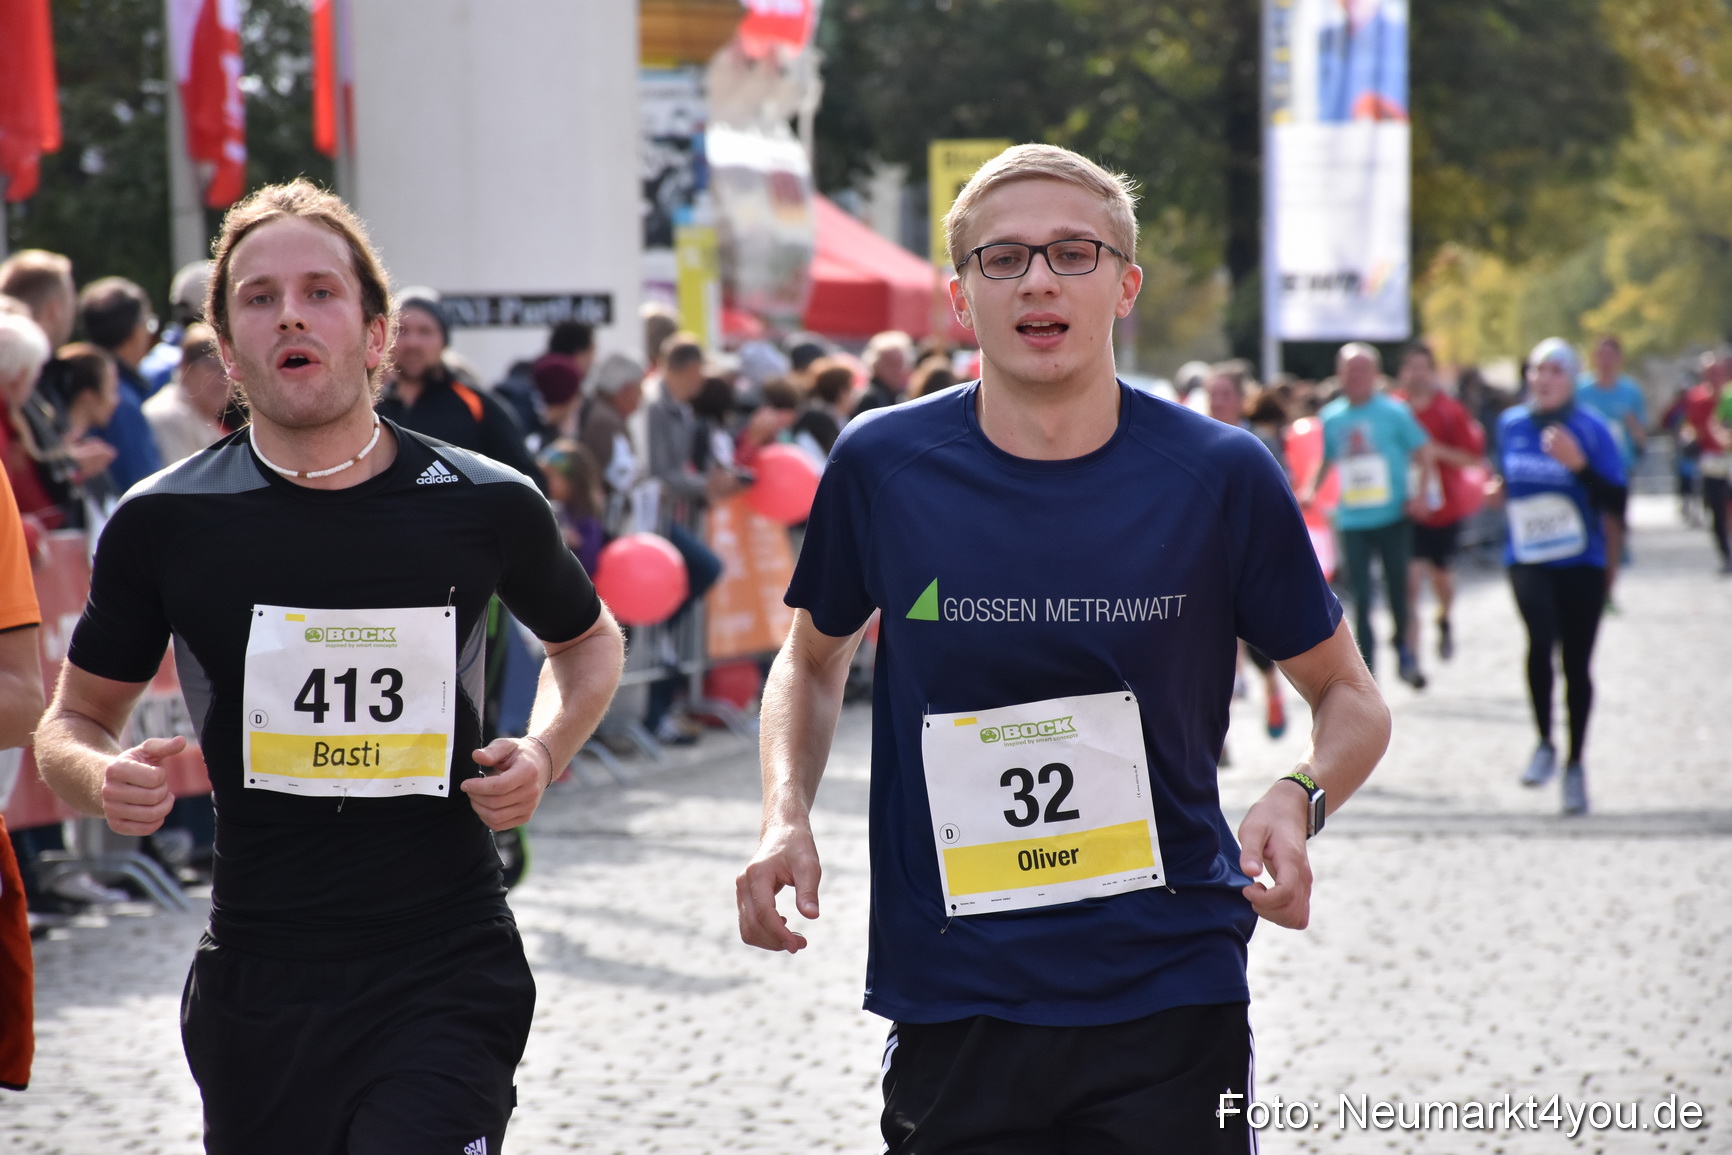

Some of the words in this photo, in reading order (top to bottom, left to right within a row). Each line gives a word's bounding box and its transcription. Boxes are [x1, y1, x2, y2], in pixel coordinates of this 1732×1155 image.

[416, 474, 459, 485] adidas
[943, 597, 1036, 622] GOSSEN
[1045, 594, 1187, 622] METRAWATT
[326, 627, 397, 643] BOCK
[293, 667, 404, 724] 413
[255, 714, 263, 724] D
[1001, 715, 1077, 741] BOCK
[1003, 739, 1027, 748] inspired
[1036, 736, 1053, 744] smart
[1053, 733, 1079, 742] concepts
[312, 740, 380, 768] Basti
[1000, 762, 1081, 828] 32
[945, 828, 954, 840] D
[1017, 847, 1080, 872] Oliver
